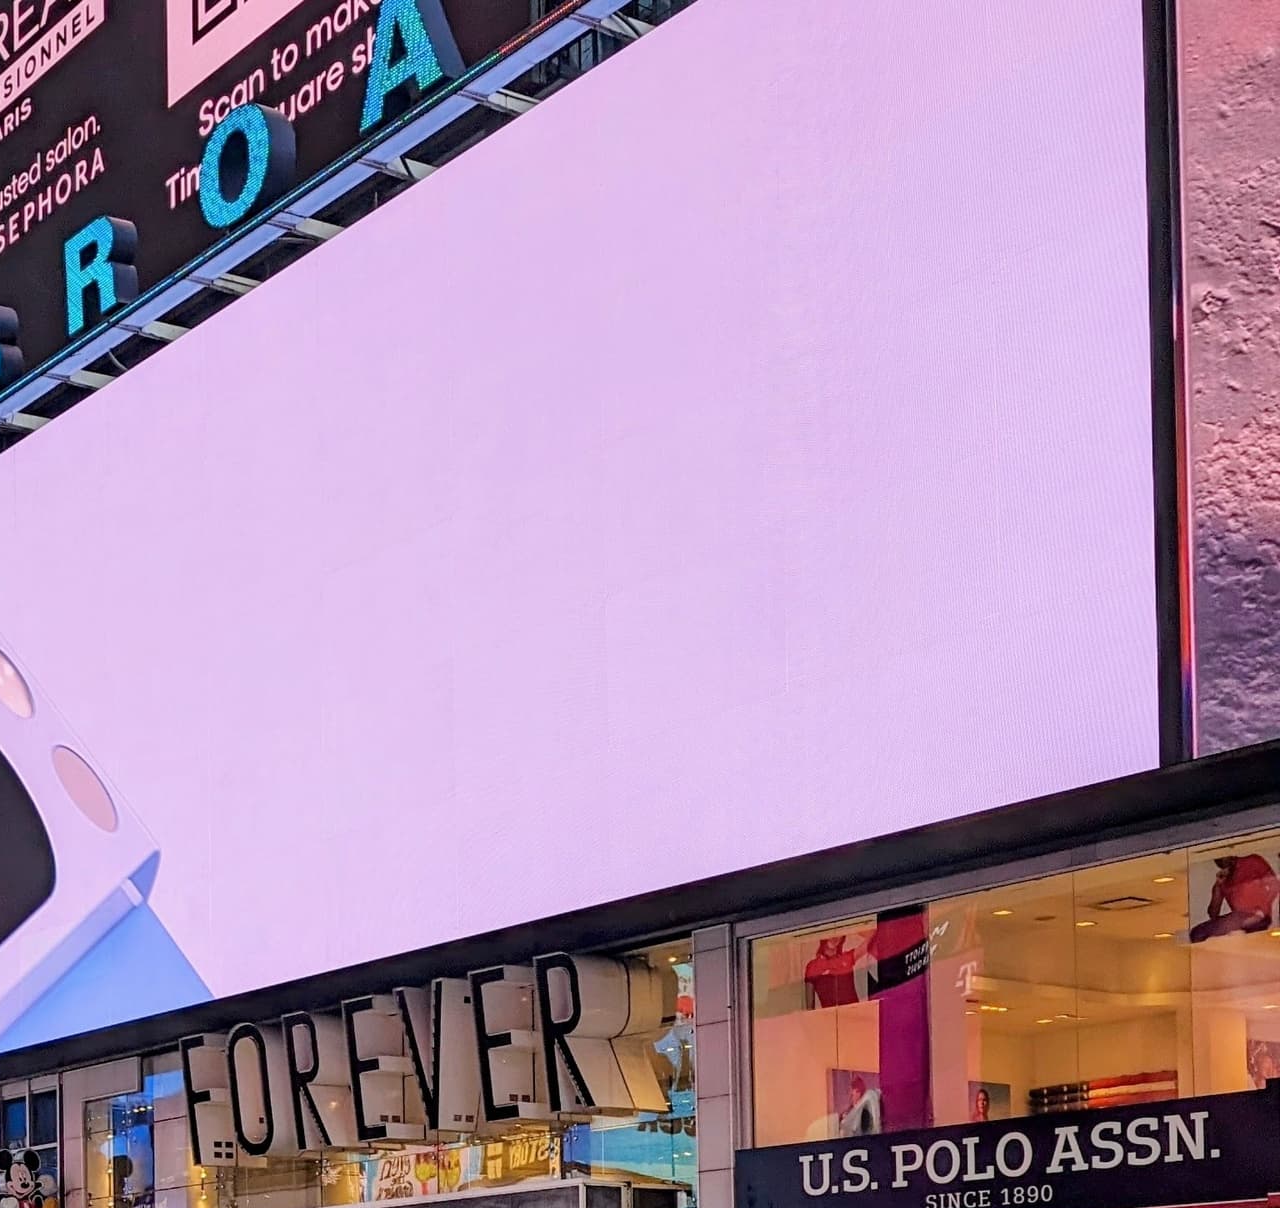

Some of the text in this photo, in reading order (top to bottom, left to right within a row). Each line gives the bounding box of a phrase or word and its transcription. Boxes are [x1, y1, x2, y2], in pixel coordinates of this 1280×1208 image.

[198, 68, 265, 136] Scan
[271, 43, 298, 81] to
[305, 0, 379, 57] mak
[45, 114, 101, 172] salon.
[179, 951, 596, 1166] FOREVER
[799, 1111, 1221, 1197] U.S. POLO ASSN.
[1000, 1184, 1054, 1207] 1890
